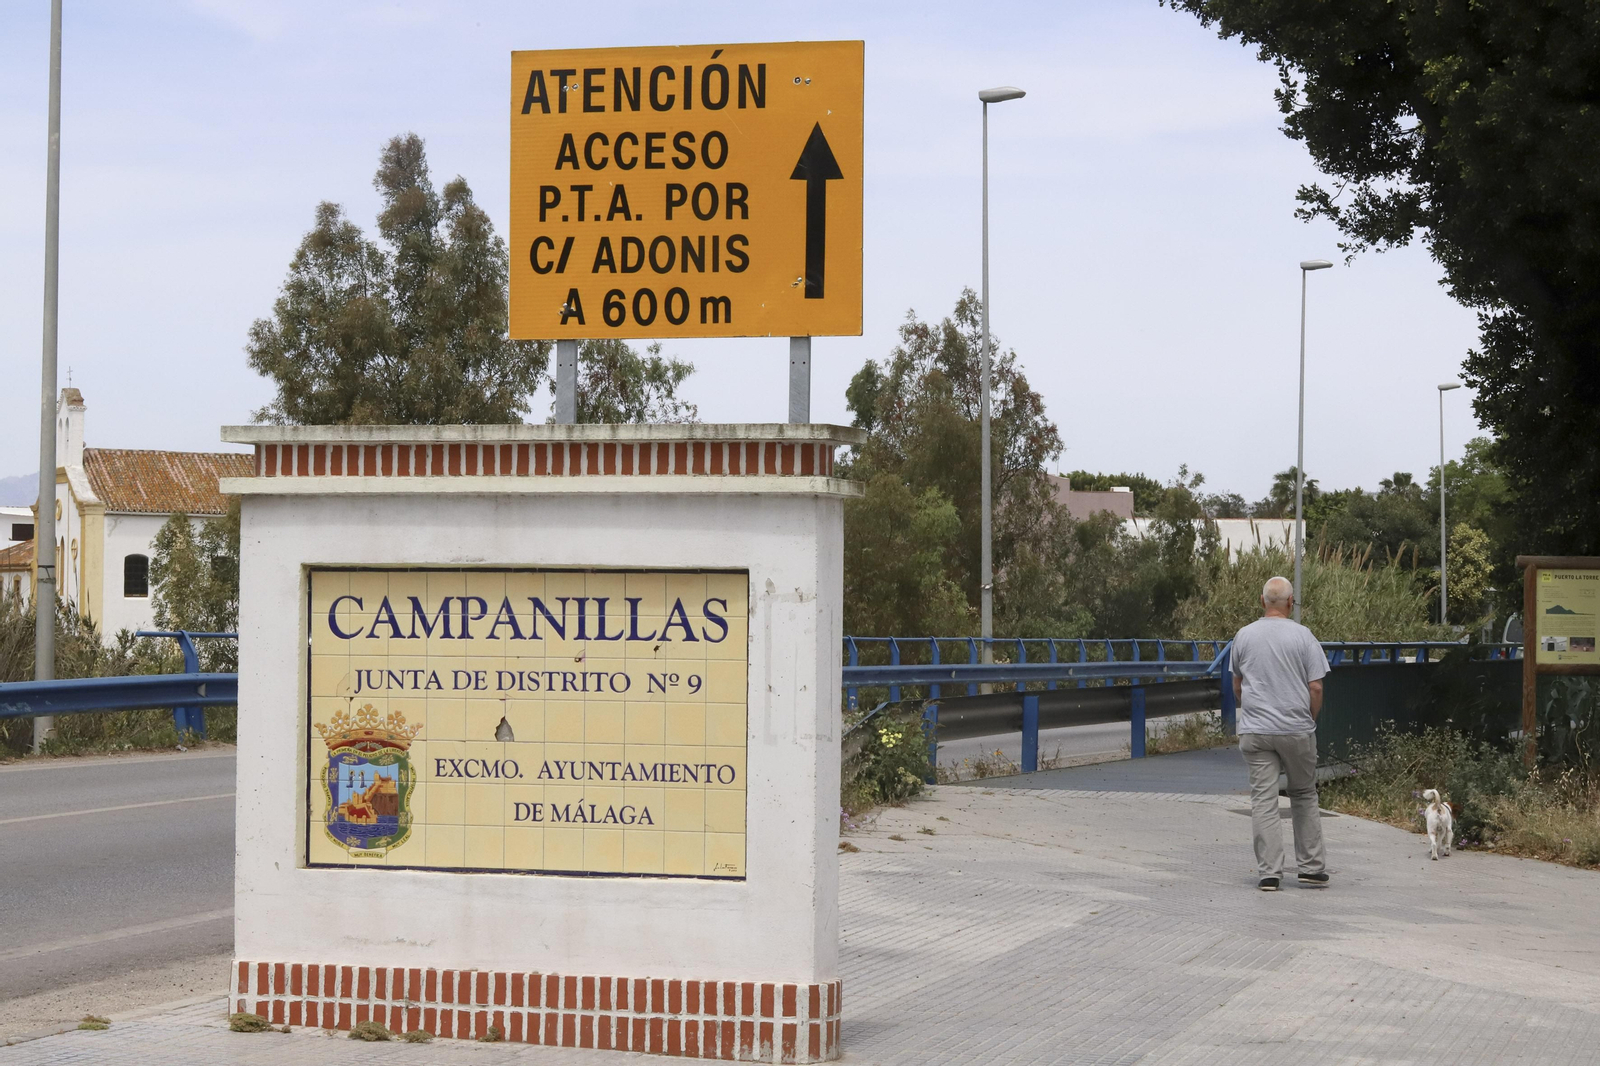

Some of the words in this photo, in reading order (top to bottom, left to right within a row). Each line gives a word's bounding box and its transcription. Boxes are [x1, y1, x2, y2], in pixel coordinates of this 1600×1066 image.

[521, 49, 766, 114] ATENCIÓN
[555, 130, 729, 170] ACCESO
[539, 184, 643, 222] P.T.A.
[665, 182, 750, 221] POR
[530, 236, 575, 275] C/
[592, 234, 750, 275] ADONIS
[560, 288, 586, 325] A
[328, 595, 729, 643] CAMPANILLAS
[354, 669, 442, 695] JUNTA
[452, 670, 487, 690] DE
[496, 670, 630, 693] DISTRITO
[688, 674, 702, 695] 9
[434, 758, 523, 780] EXCMO.
[537, 760, 736, 784] AYUNTAMIENTO
[514, 802, 543, 822] DE
[551, 798, 655, 825] MÁLAGA
